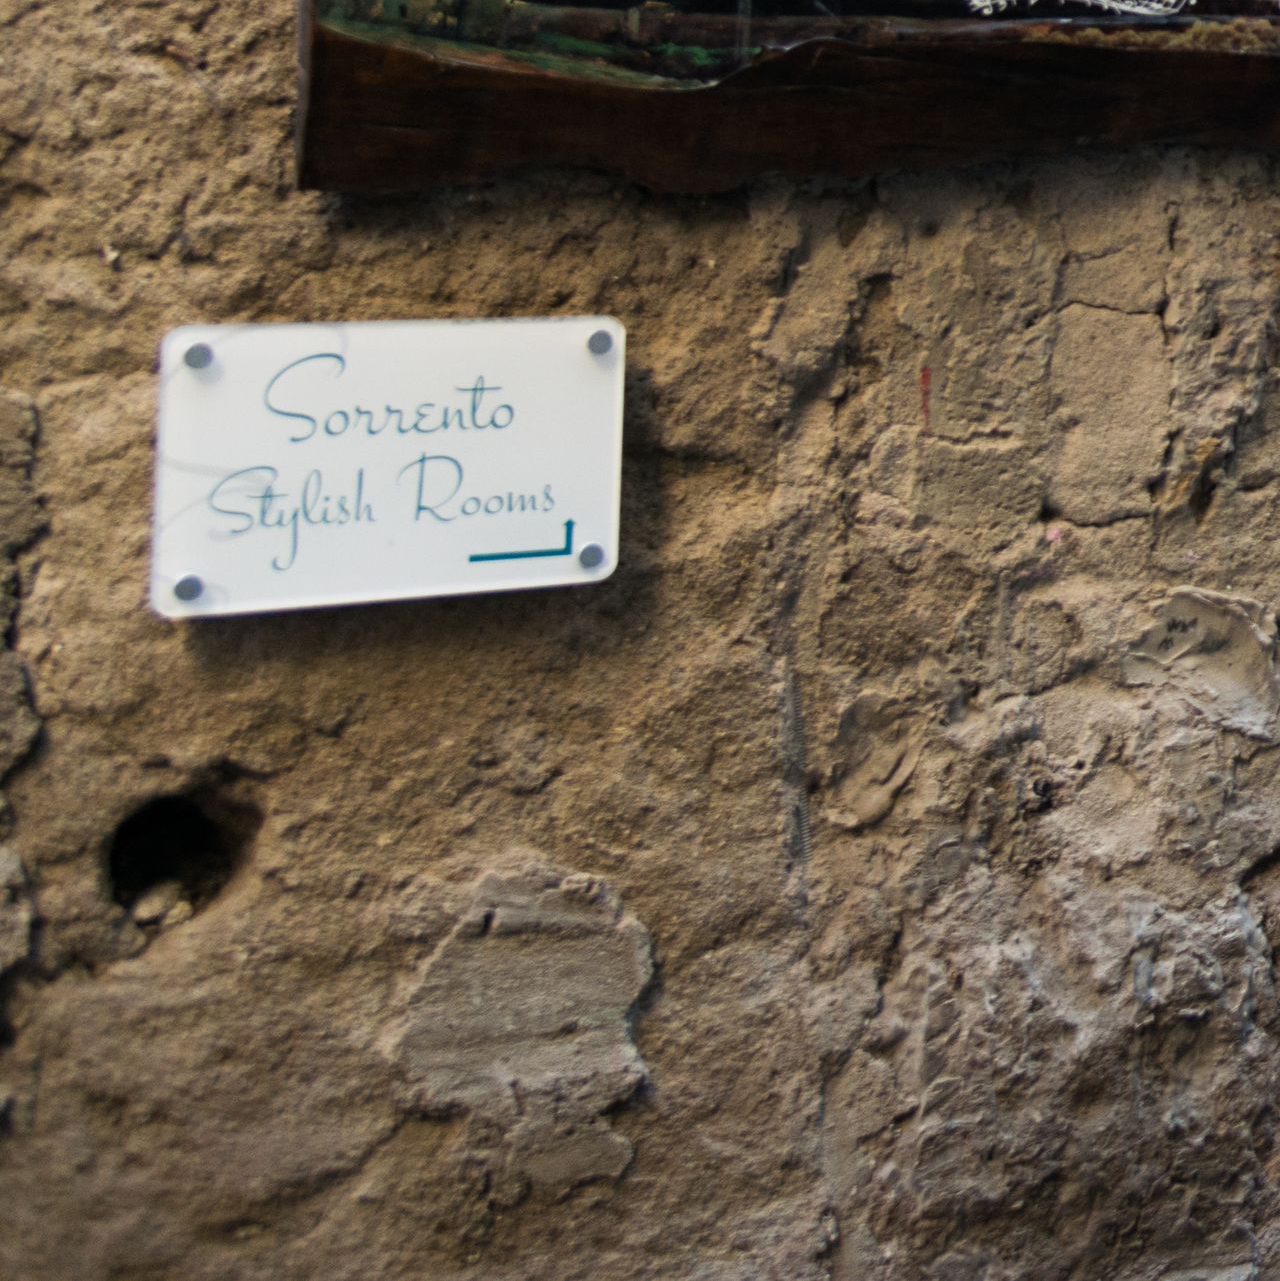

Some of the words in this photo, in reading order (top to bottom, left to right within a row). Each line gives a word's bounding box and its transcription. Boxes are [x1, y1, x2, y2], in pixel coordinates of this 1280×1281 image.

[264, 352, 516, 444] Sorrento
[208, 464, 376, 571] Stylish
[397, 452, 556, 523] Rooms
